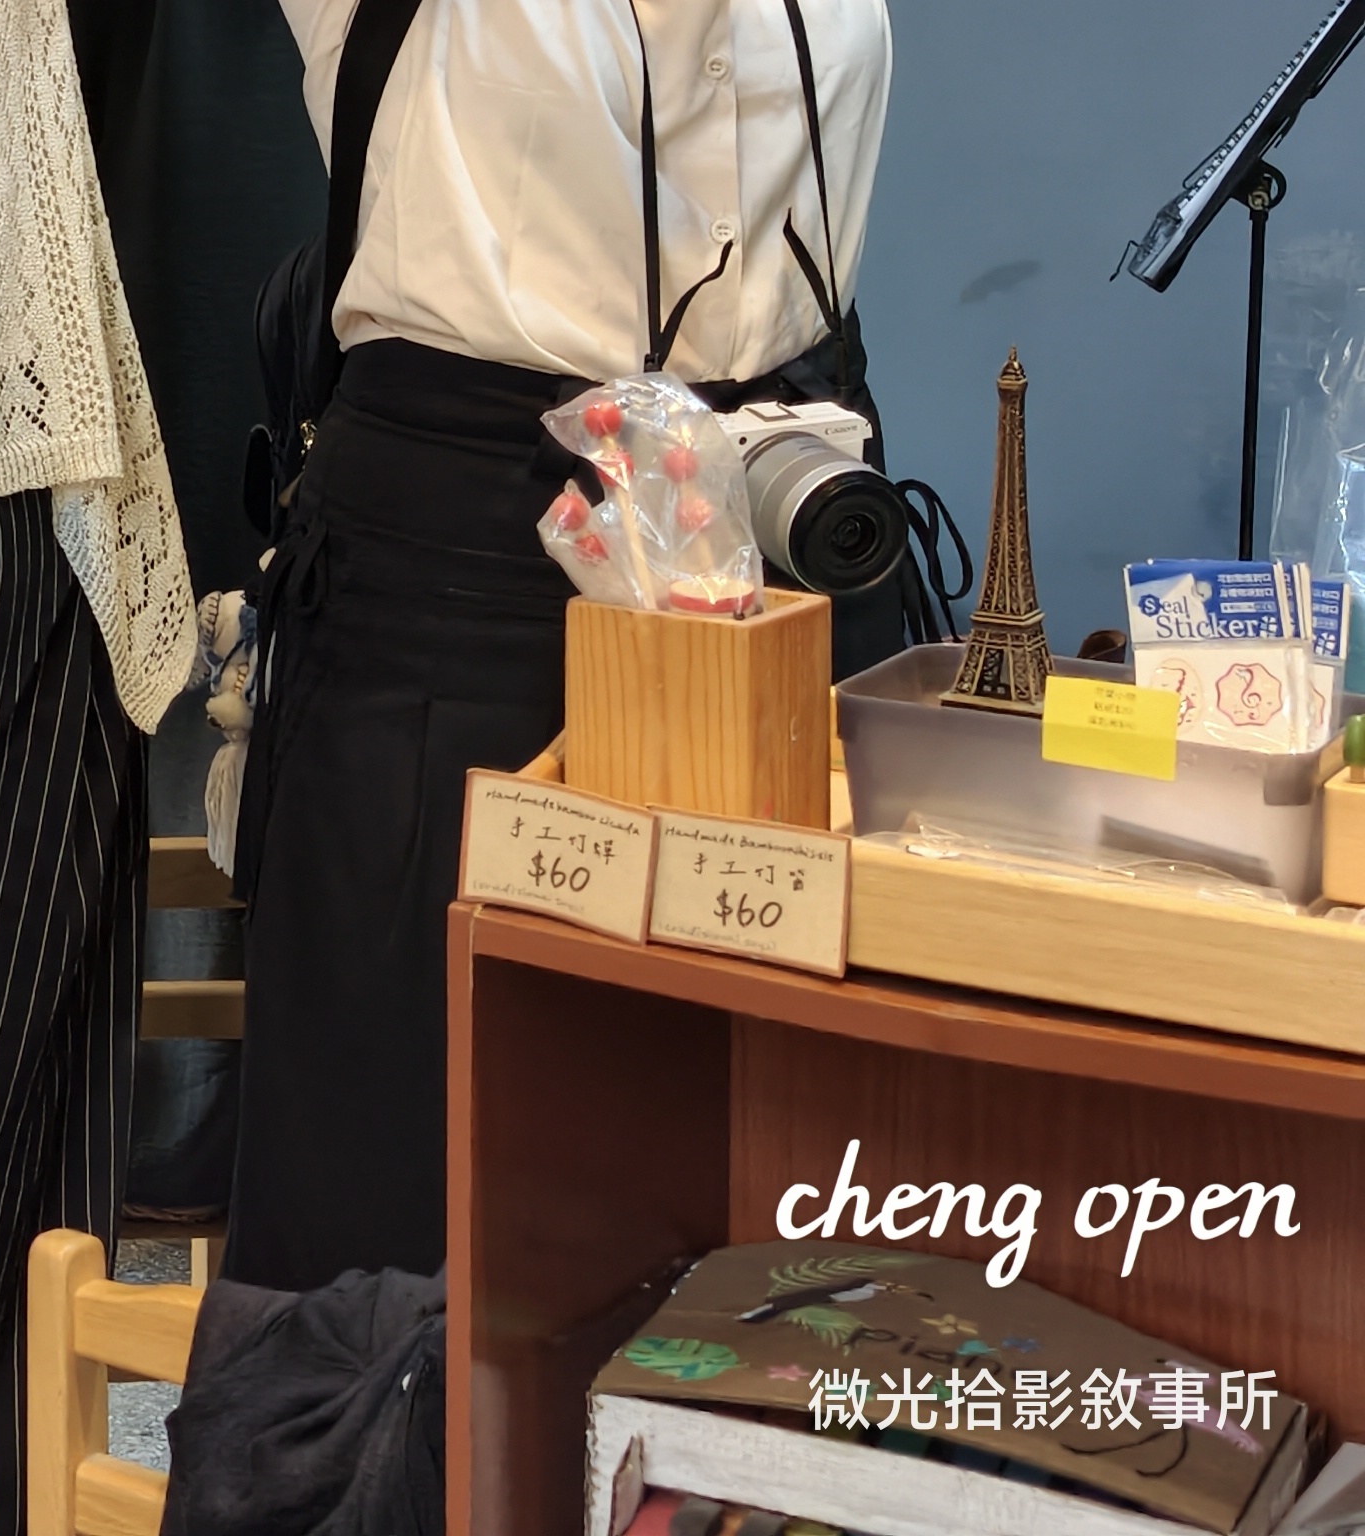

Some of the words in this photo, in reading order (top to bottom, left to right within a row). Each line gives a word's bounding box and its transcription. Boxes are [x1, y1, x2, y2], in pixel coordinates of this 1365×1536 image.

[1139, 594, 1189, 617] Seal
[1156, 613, 1259, 640] Sticker
[527, 850, 591, 892] $60
[713, 888, 783, 928] $60
